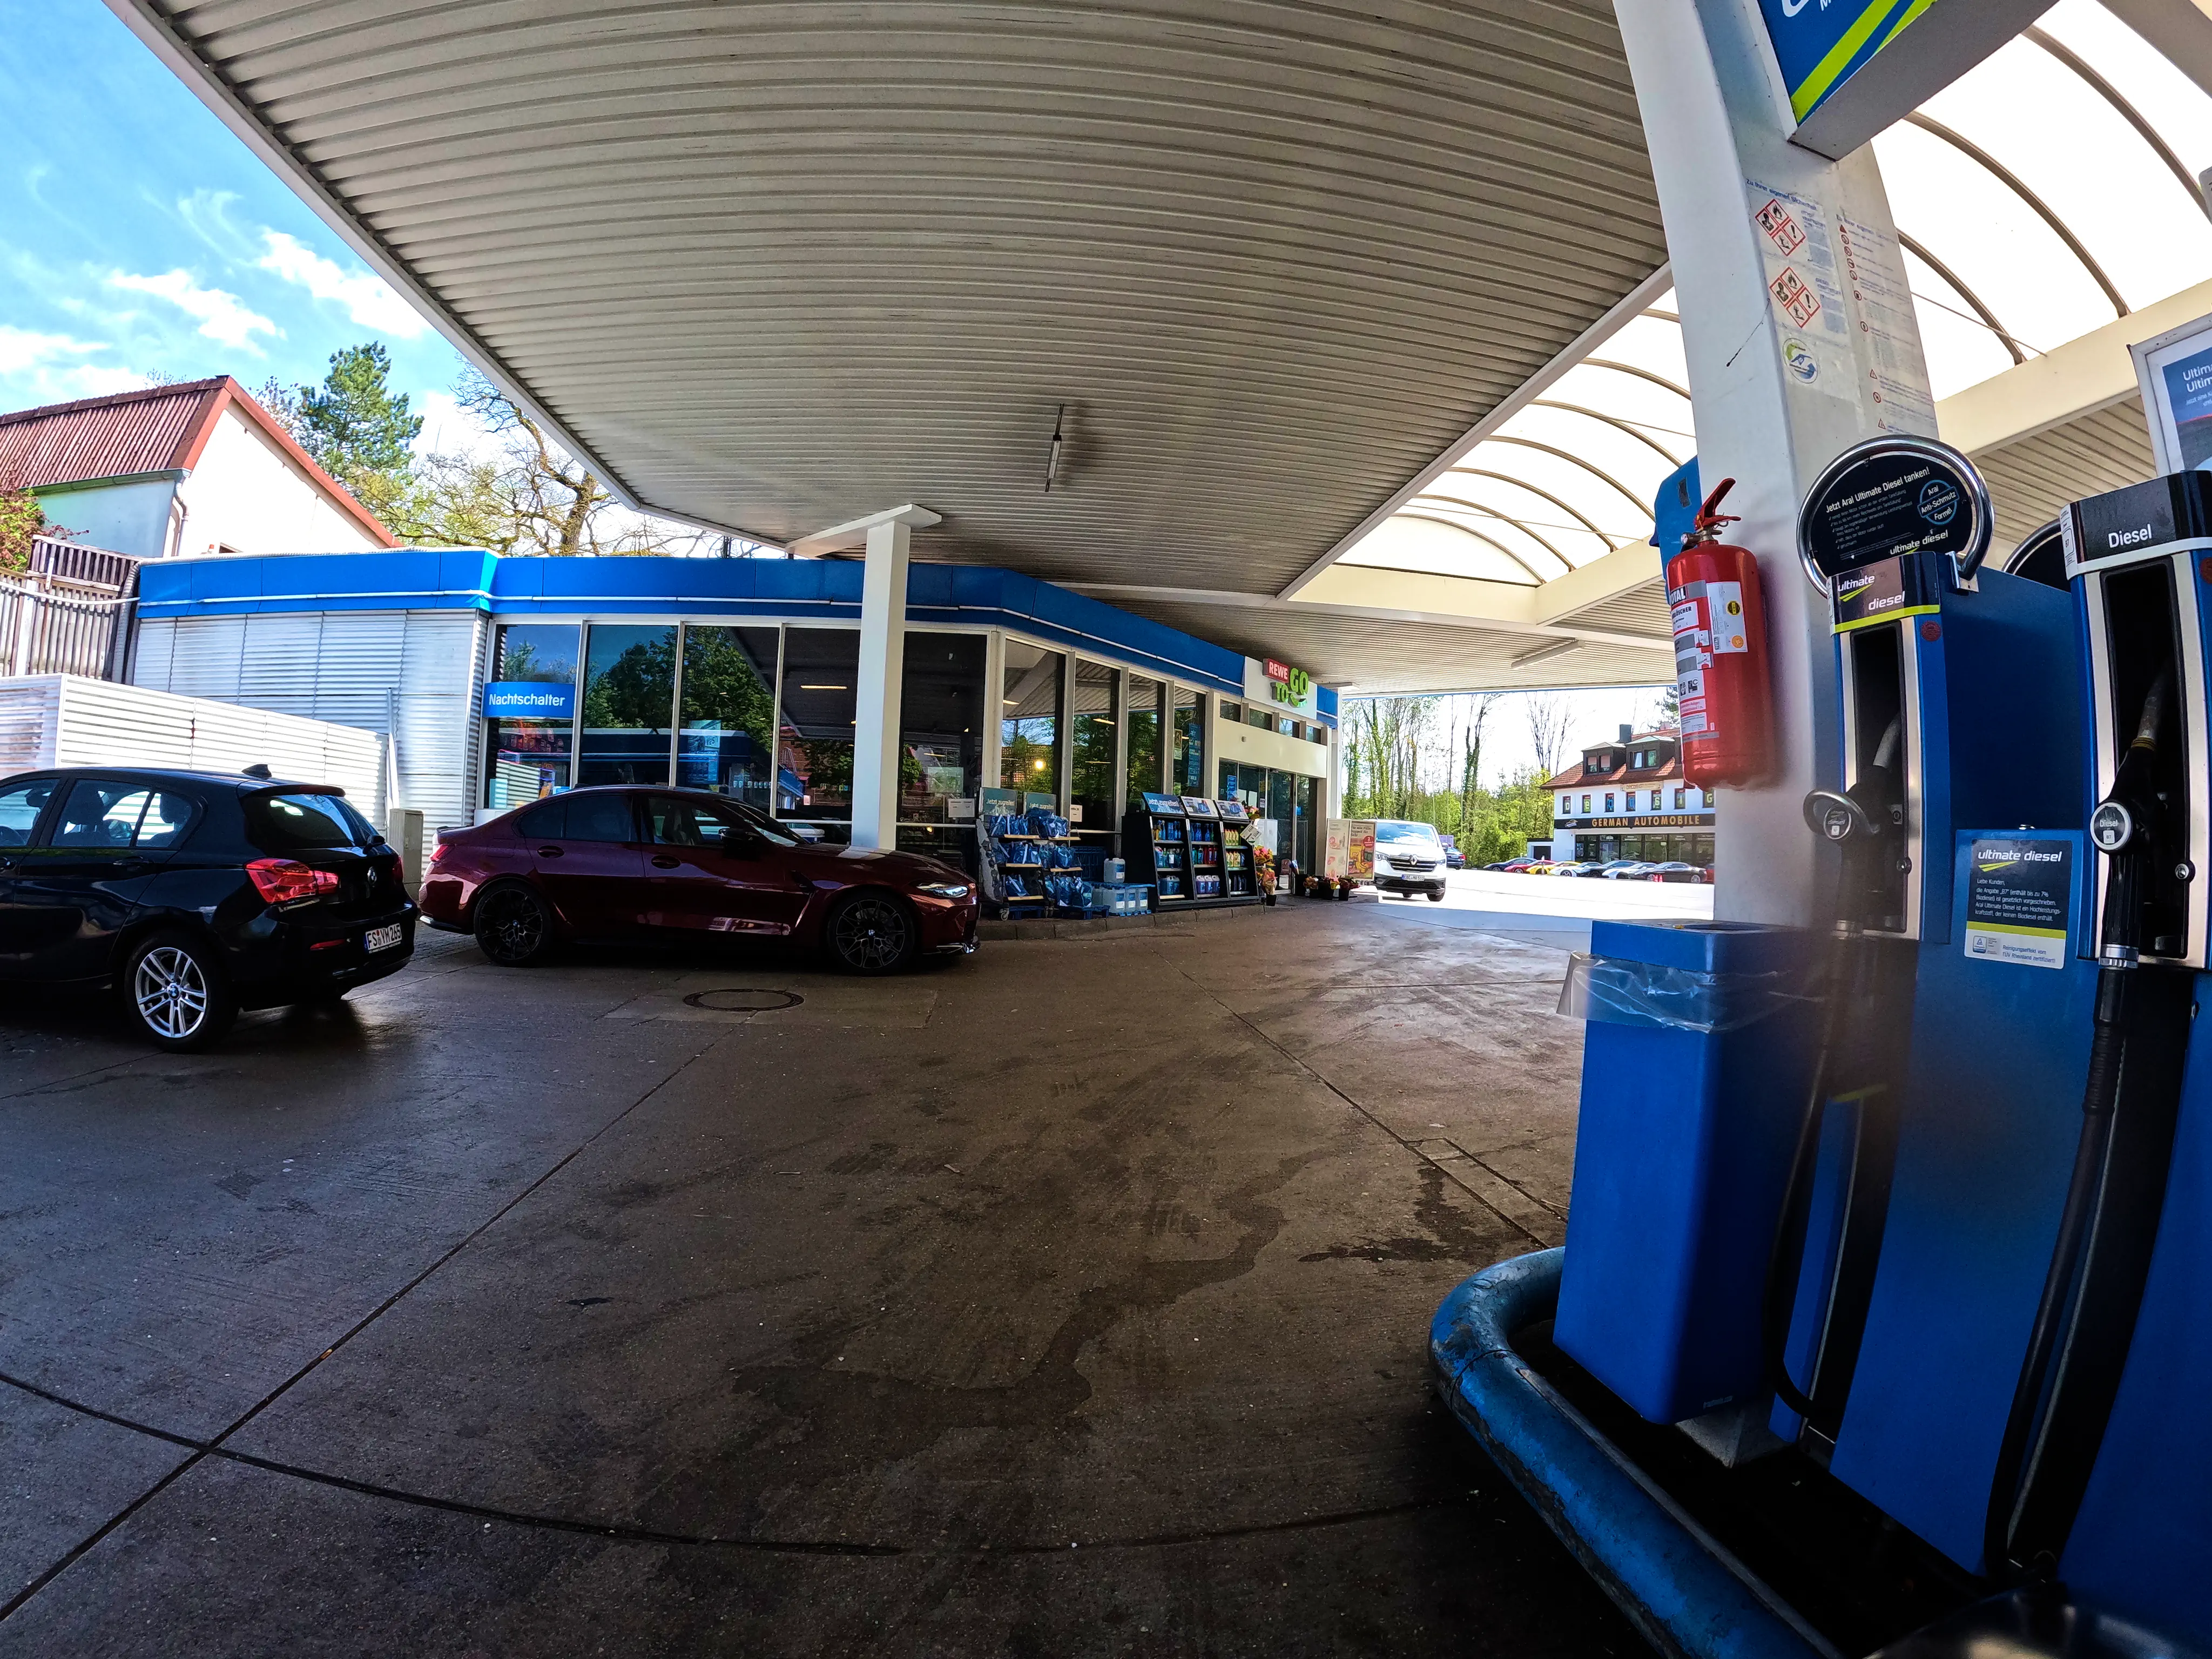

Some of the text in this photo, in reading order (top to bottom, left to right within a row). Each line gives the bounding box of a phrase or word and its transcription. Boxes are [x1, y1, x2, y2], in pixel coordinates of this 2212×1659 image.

[1826, 466, 1930, 513] Jetzt Aral Ultimate Diesel tanken!
[1927, 485, 1939, 496] Aral
[1920, 491, 1957, 514] Anti-Schmutz
[1934, 507, 1953, 520] Formel
[1890, 540, 1920, 555] ultimate
[1921, 529, 1948, 545] diesel
[2108, 524, 2153, 548] Diesel
[1837, 575, 1875, 592] ultimate
[1670, 586, 1686, 605] OTAL
[1868, 591, 1905, 611] diesel
[1269, 661, 1288, 680] REWE
[1276, 667, 1309, 703] TO GO
[489, 693, 565, 706] Nachtschalter
[1591, 815, 1700, 827] GERMAN AUTOMOBILE
[2100, 819, 2118, 827] Diesel
[1978, 849, 2062, 862] ultimate diesel
[2029, 906, 2061, 915] Hochleistungs-
[367, 932, 377, 948] FS
[380, 928, 390, 944] YM
[390, 924, 401, 941] 265
[2002, 945, 2036, 954] Reinigungseffekt
